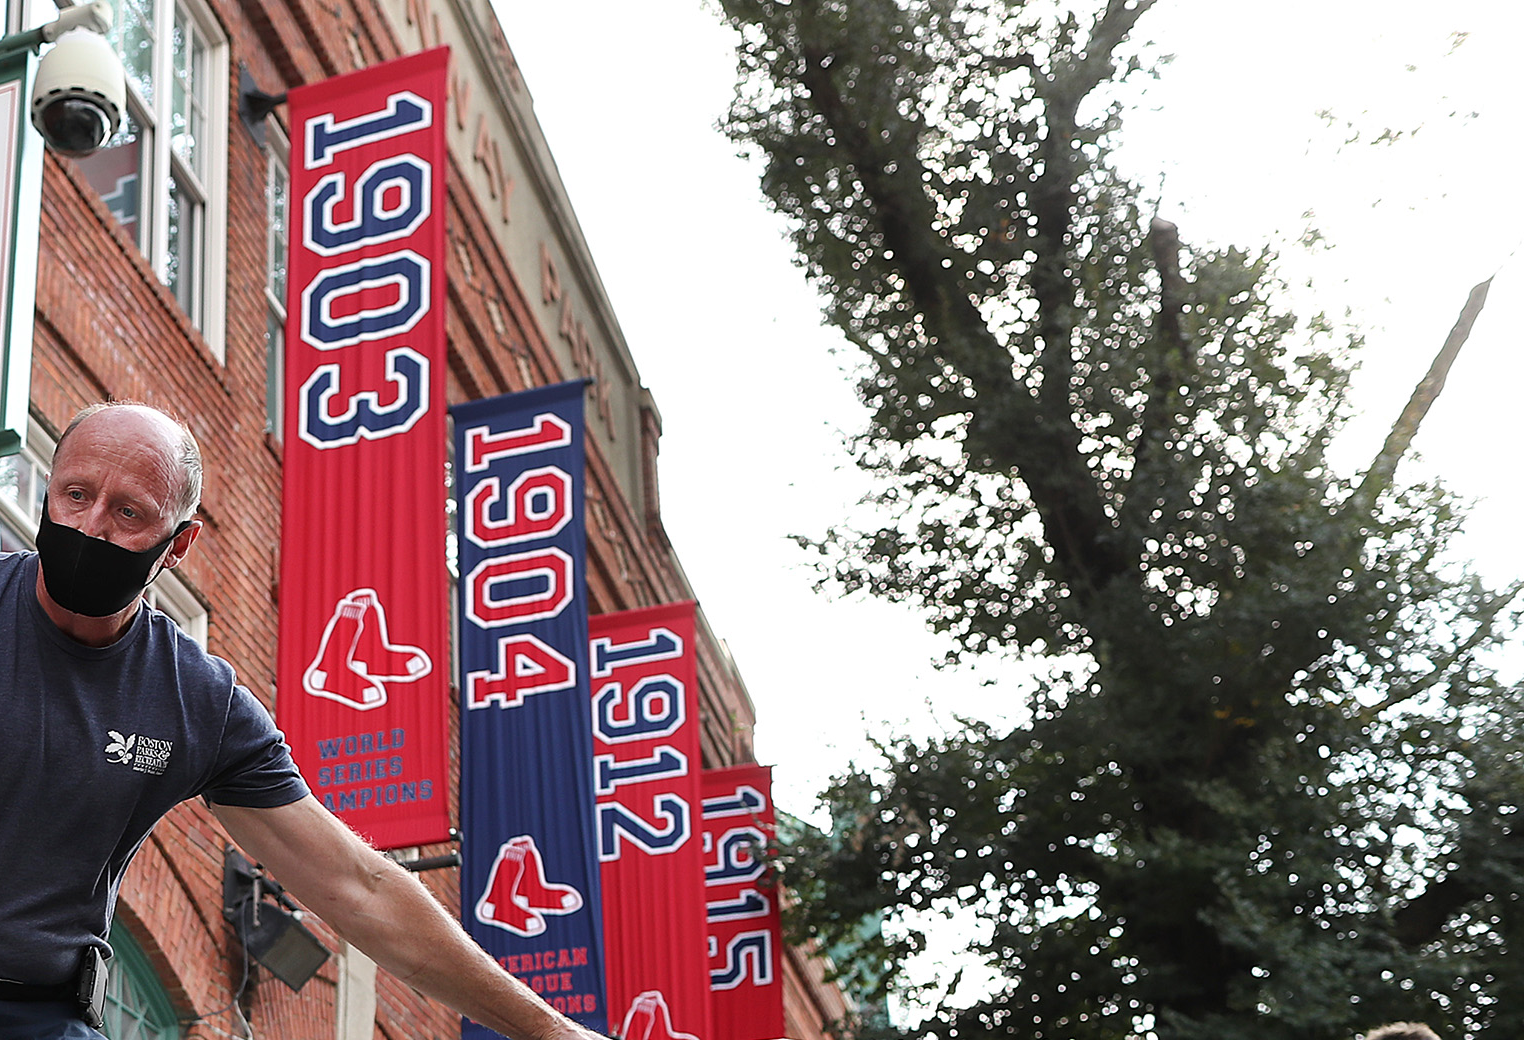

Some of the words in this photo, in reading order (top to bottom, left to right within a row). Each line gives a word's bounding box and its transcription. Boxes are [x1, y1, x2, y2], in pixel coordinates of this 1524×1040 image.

[299, 90, 432, 450] 1903
[464, 412, 577, 710] 1904
[138, 736, 173, 751] BOSTON
[317, 728, 405, 759] WORLD
[590, 627, 692, 863] 1912
[318, 756, 403, 786] SERIES
[323, 779, 433, 812] AMPIONS
[700, 785, 773, 991] 1915
[497, 947, 588, 973] ERICAN
